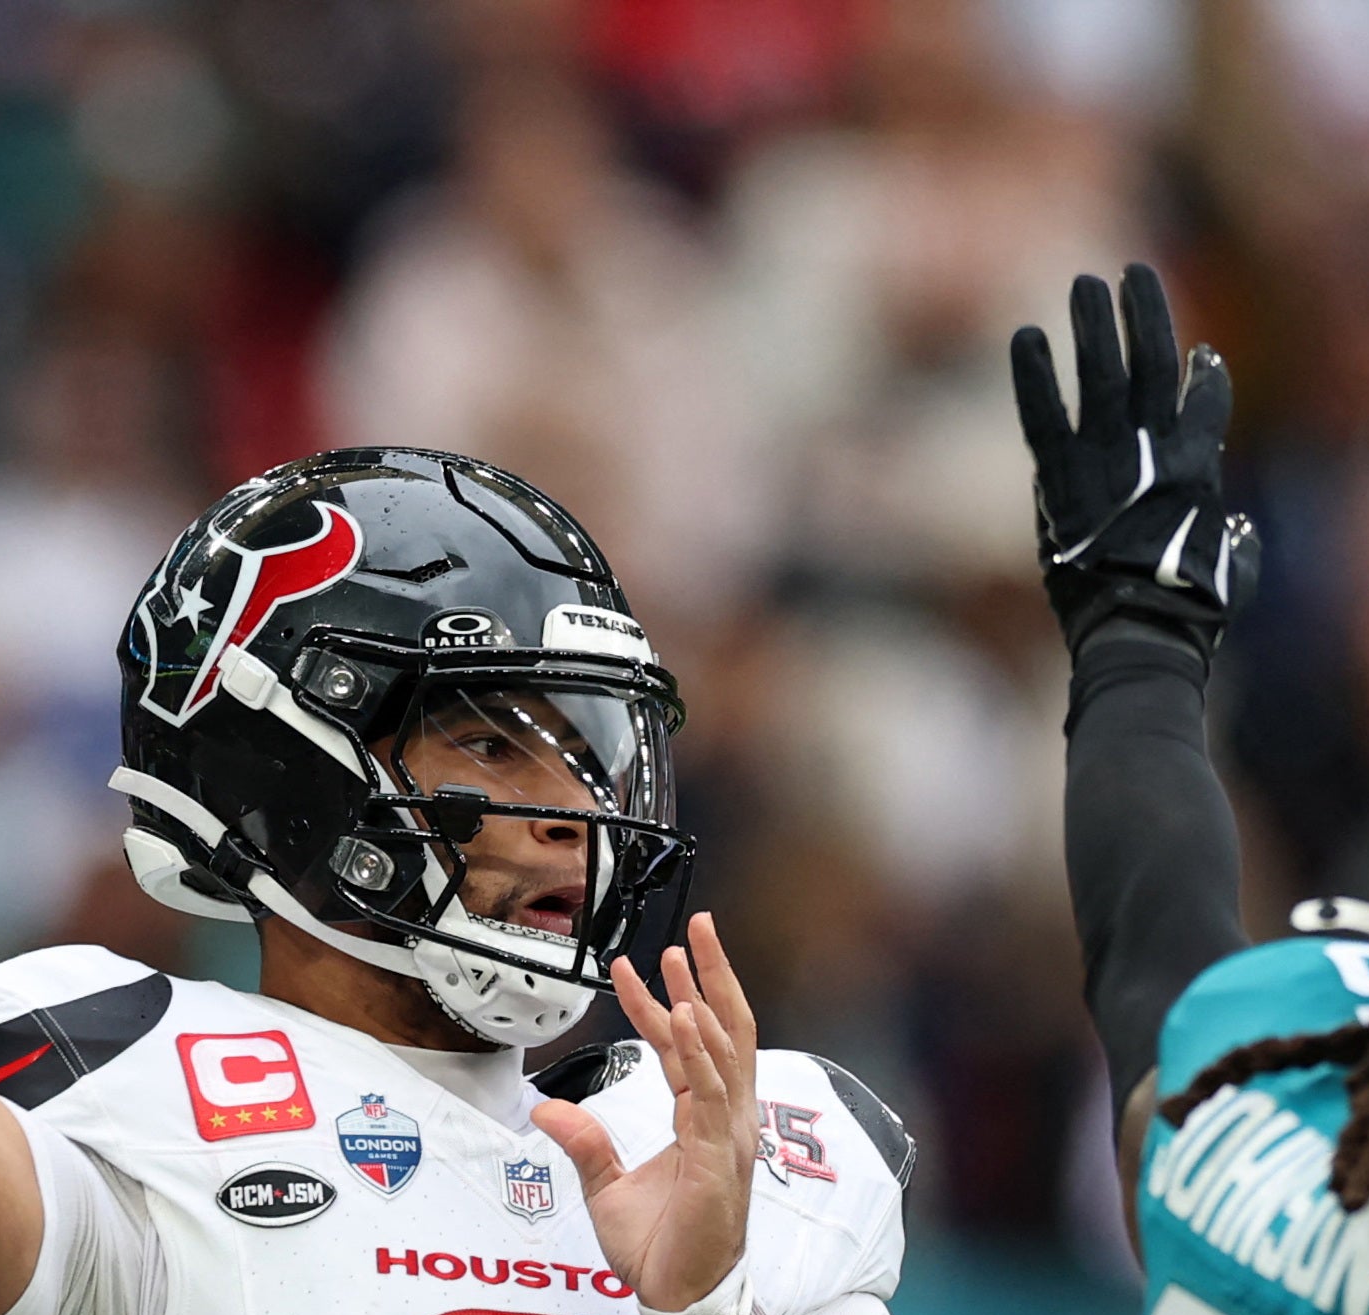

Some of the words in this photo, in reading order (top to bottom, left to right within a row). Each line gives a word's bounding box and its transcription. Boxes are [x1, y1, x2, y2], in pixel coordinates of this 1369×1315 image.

[562, 610, 646, 641] TEXANS
[424, 635, 506, 648] OAKLEY
[189, 1036, 298, 1108] C
[363, 1103, 388, 1118] NFL
[344, 1138, 417, 1153] LONDON
[753, 1098, 826, 1166] 5
[367, 1152, 399, 1160] GAMES
[228, 1183, 275, 1210] RCM
[282, 1181, 325, 1205] JSM
[510, 1181, 551, 1210] NFL
